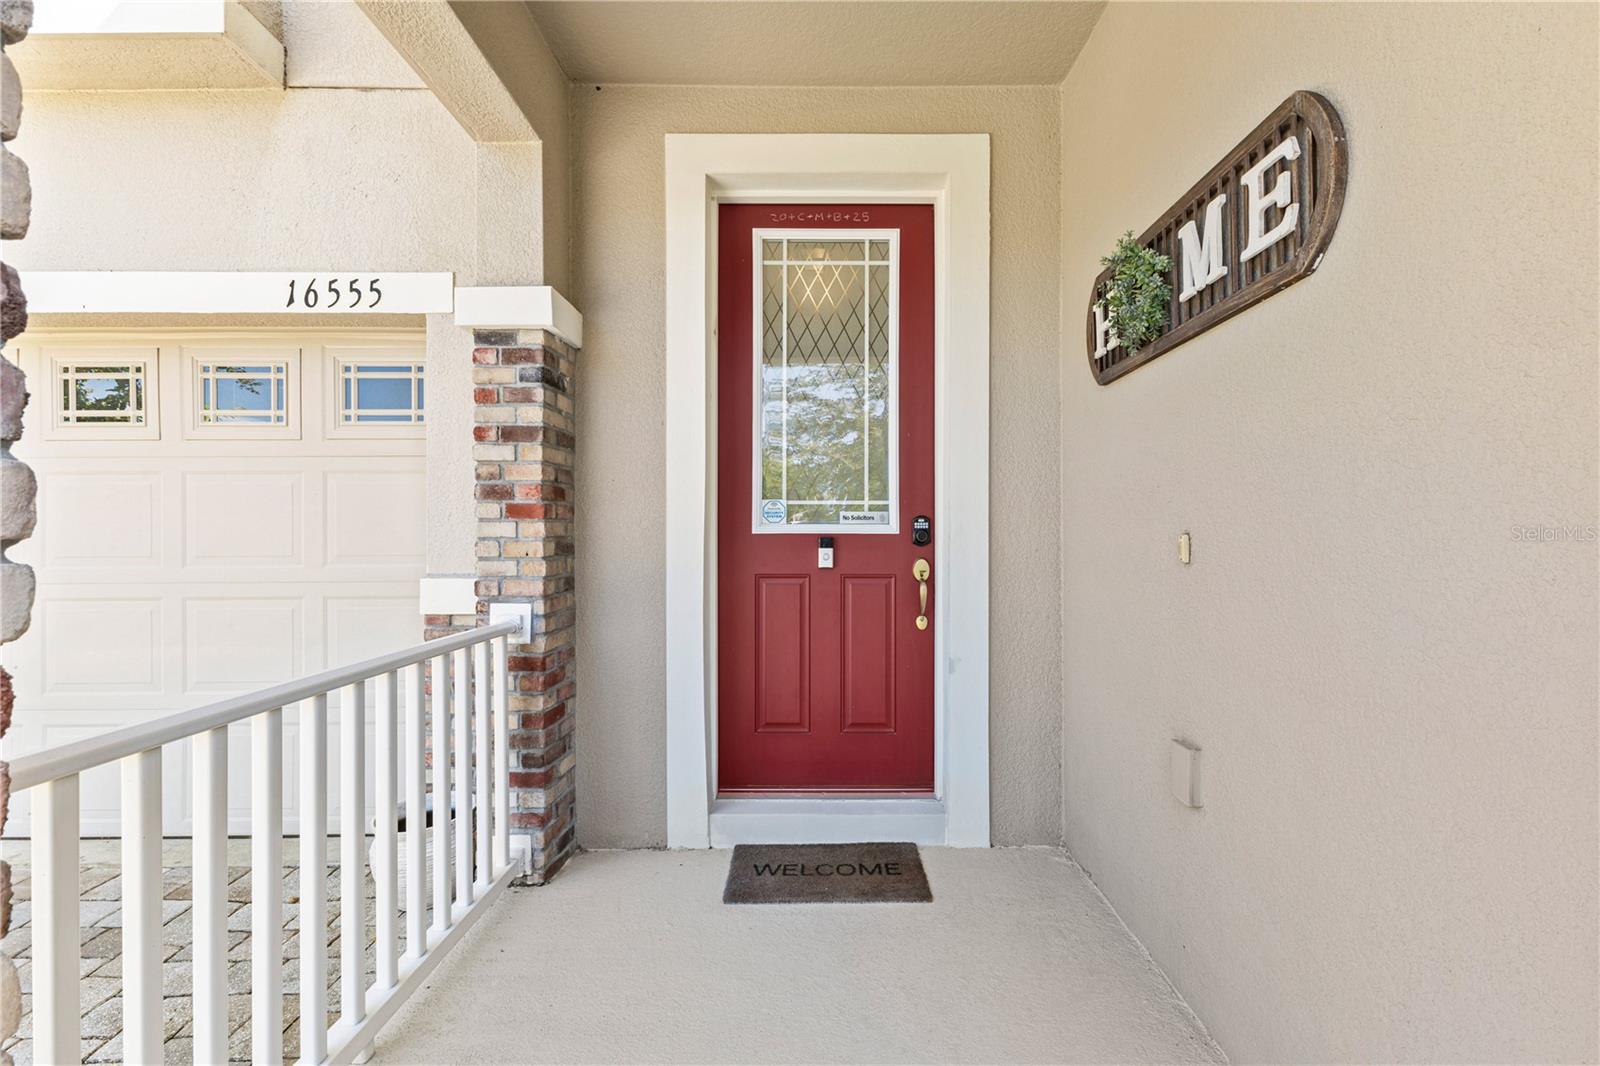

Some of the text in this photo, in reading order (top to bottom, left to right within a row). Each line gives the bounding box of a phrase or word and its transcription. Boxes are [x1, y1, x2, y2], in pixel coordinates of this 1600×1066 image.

[1093, 135, 1301, 360] HME
[286, 278, 382, 308] 16555
[753, 862, 902, 876] WELCOME
